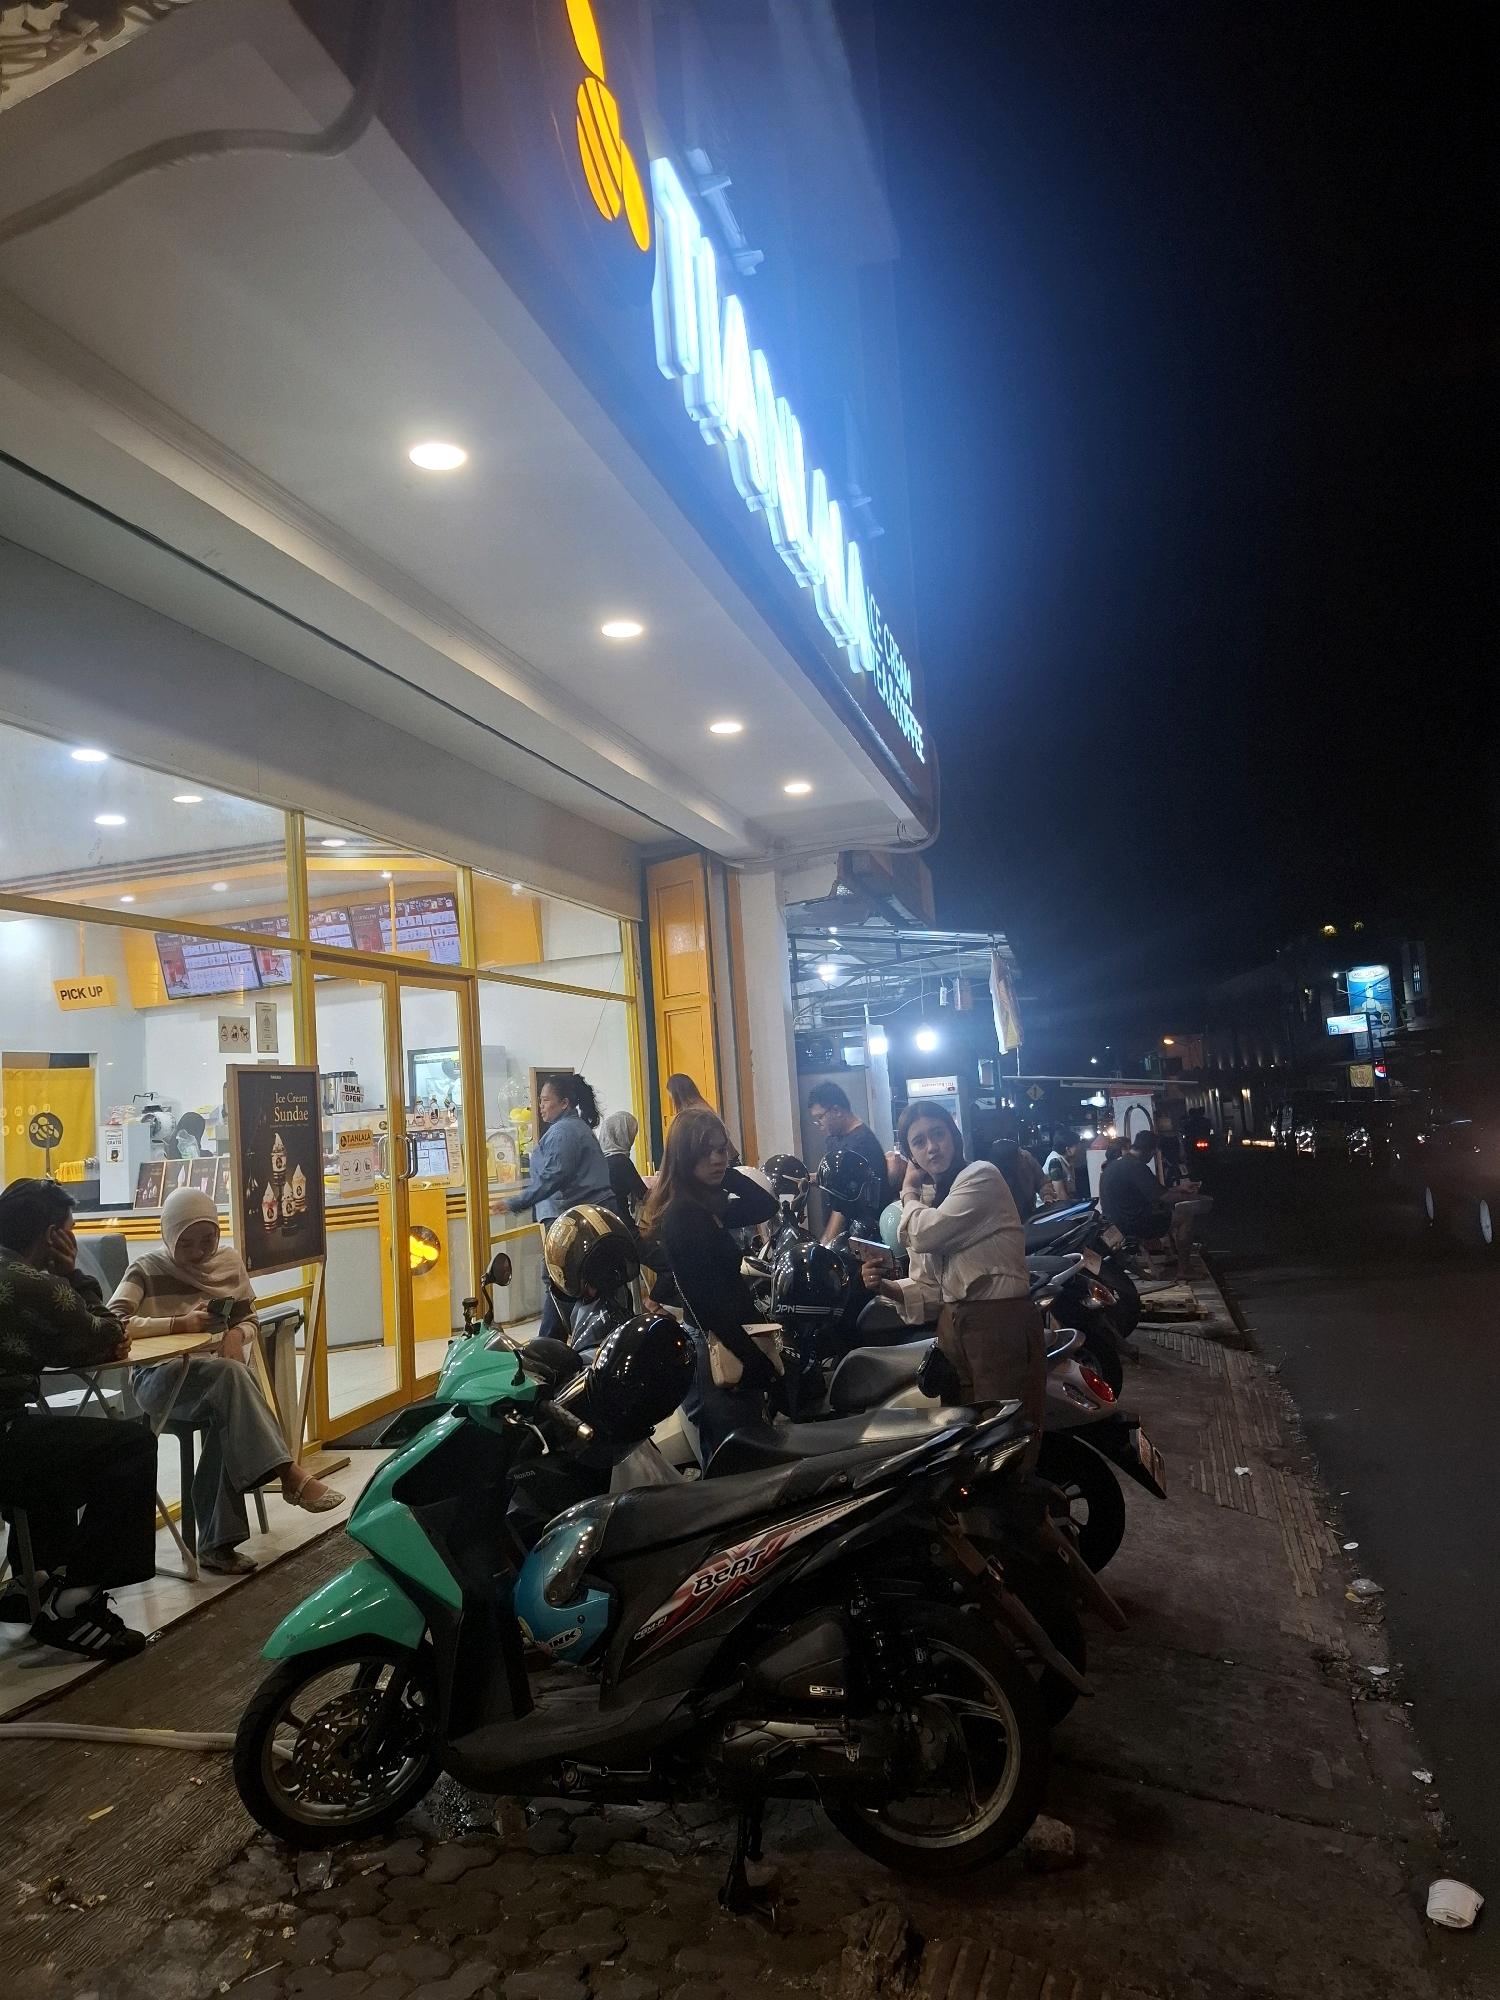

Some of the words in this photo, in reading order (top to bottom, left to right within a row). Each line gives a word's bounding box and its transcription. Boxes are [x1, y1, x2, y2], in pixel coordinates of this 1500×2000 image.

[866, 585, 883, 653] ICE
[883, 622, 913, 707] CREAM
[60, 988, 87, 1001] PICK
[87, 985, 103, 998] UP
[344, 1084, 361, 1094] BUKA
[275, 1092, 286, 1104] Ice
[286, 1092, 308, 1104] Cream
[274, 1105, 309, 1122] Sundae
[775, 1304, 795, 1313] JPN
[513, 1470, 536, 1480] HONDA
[633, 1615, 668, 1640] PGM-FI
